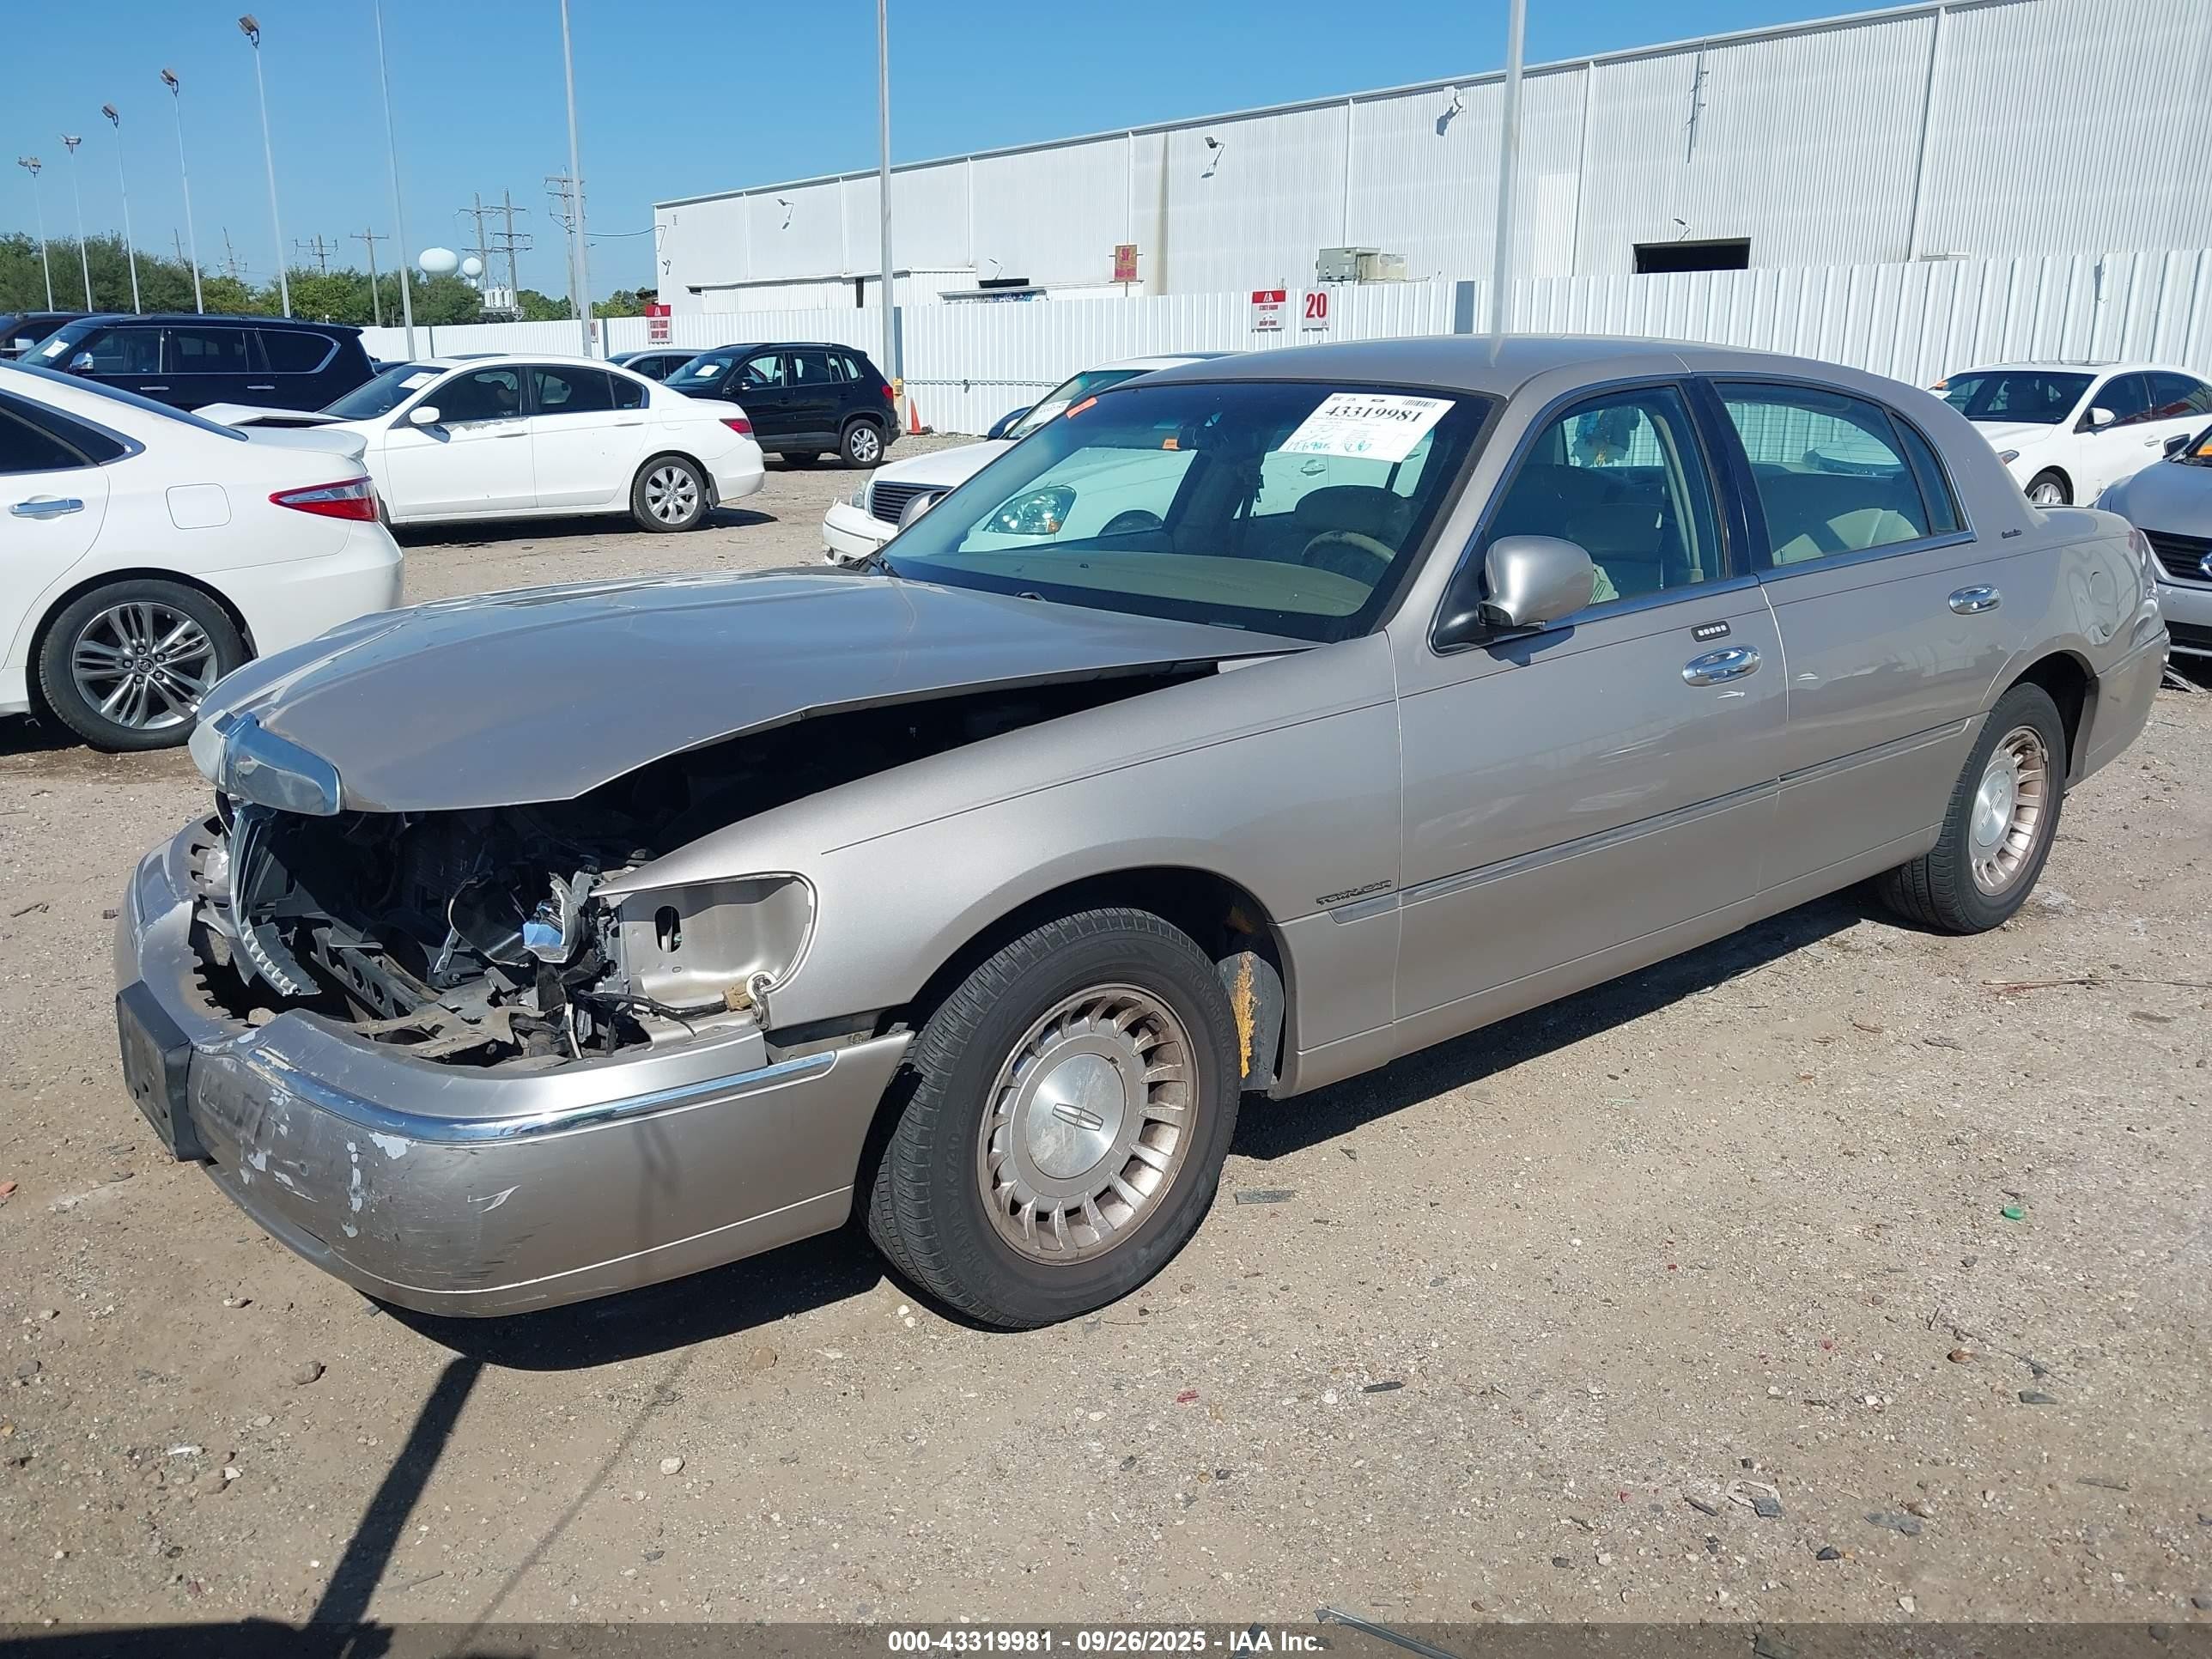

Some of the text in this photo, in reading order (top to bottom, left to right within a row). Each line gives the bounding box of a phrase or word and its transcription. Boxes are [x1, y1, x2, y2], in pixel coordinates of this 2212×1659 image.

[1305, 293, 1327, 318] 20
[1325, 405, 1423, 422] 43319981
[1316, 879, 1392, 905] TOWN CAR
